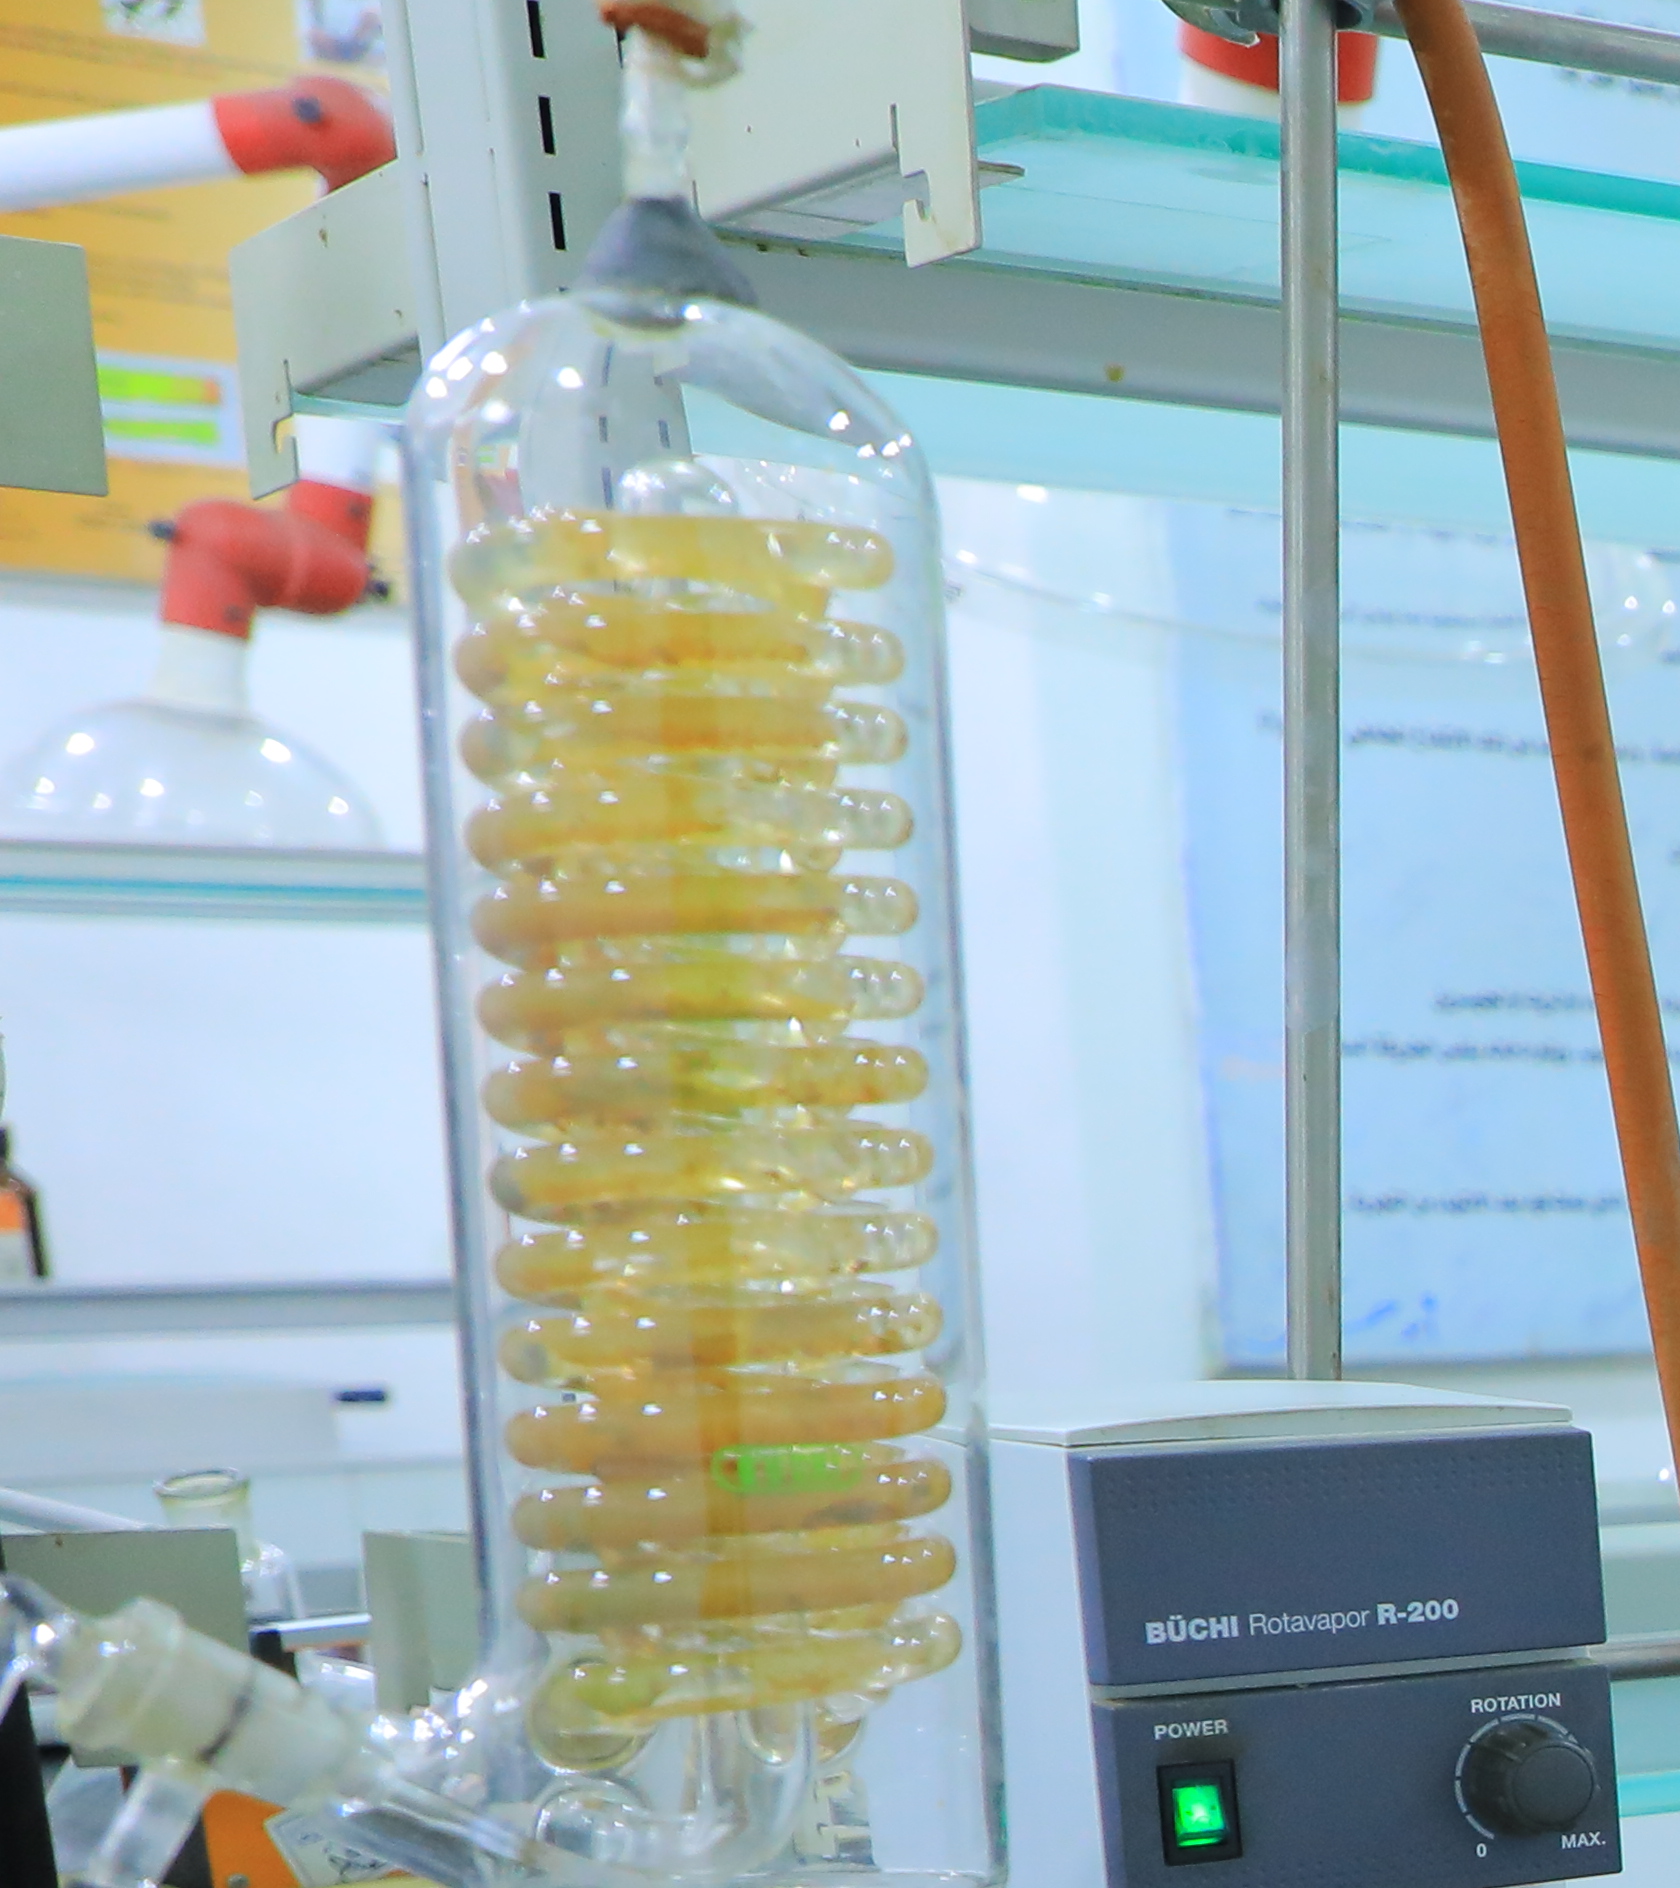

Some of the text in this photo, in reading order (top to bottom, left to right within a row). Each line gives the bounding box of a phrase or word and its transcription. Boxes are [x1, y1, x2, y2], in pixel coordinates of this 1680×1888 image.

[1145, 1599, 1459, 1645] BÜCHI Rotavapor R-200
[1471, 1692, 1562, 1714] ROTATION
[1154, 1719, 1228, 1740] POWER
[1475, 1843, 1487, 1858] 0
[1561, 1831, 1607, 1850] MAX.
